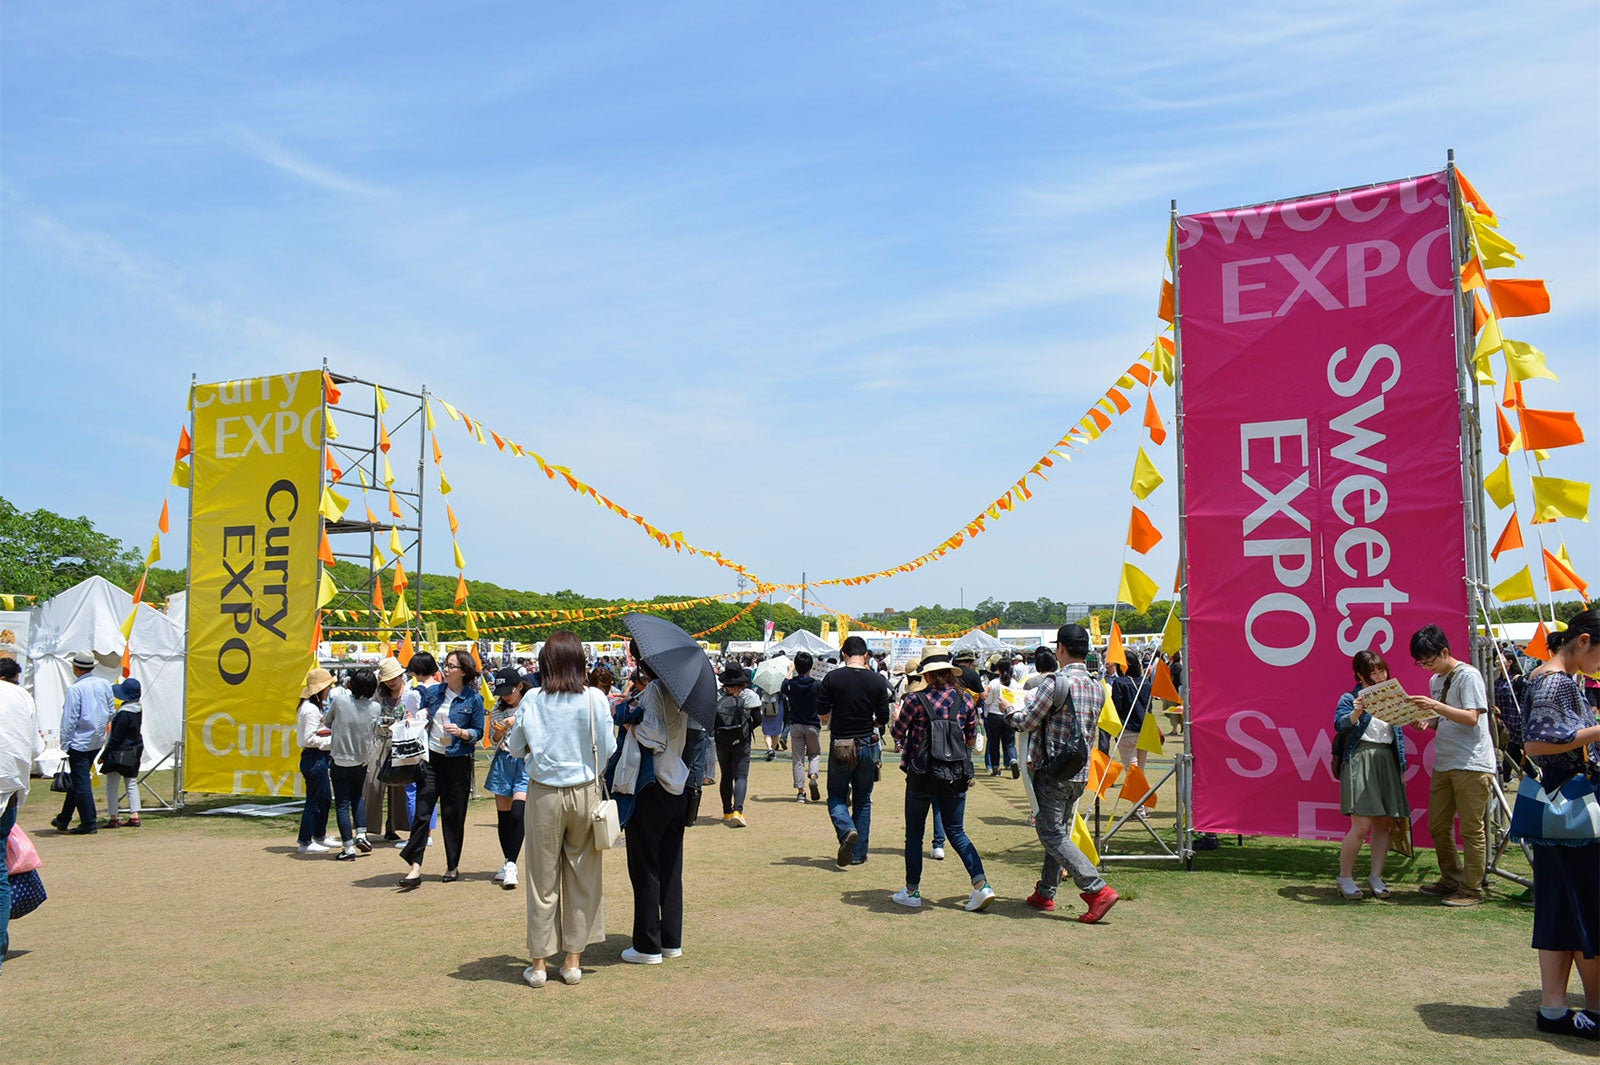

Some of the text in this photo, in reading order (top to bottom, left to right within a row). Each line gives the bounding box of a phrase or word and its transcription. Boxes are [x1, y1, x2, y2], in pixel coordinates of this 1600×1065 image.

[255, 479, 299, 641] Curry
[1240, 418, 1317, 667] EXPO
[1326, 343, 1410, 658] Sweets
[217, 525, 256, 686] EXPO
